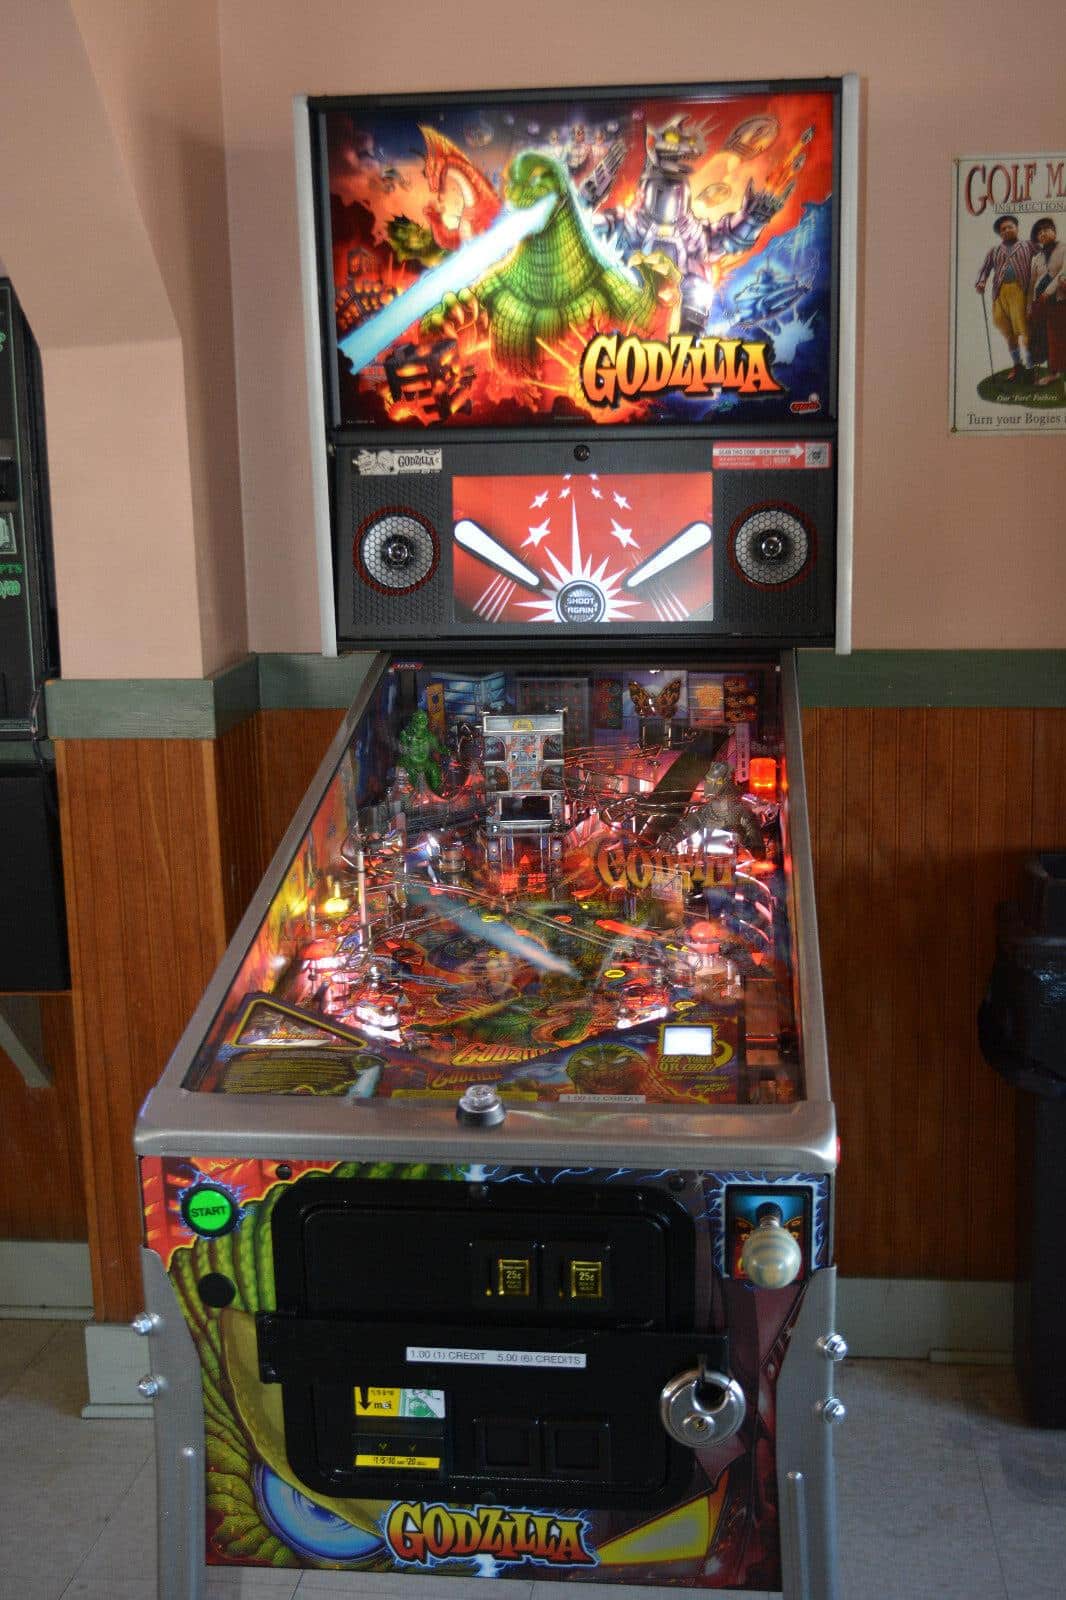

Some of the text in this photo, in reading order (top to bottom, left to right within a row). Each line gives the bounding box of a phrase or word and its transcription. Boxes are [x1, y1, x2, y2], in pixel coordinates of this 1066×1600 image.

[965, 162, 1037, 216] GOLF
[580, 332, 784, 404] GODZILLA
[967, 412, 1061, 427] Turn your Bogies
[398, 455, 434, 467] GODZILLA
[191, 1206, 226, 1218] START
[410, 1350, 431, 1360] 1.00
[433, 1350, 446, 1360] (1)
[449, 1351, 486, 1361] CREDIT
[535, 1354, 581, 1365] CREDITS
[388, 1502, 597, 1566] GODZILLA
